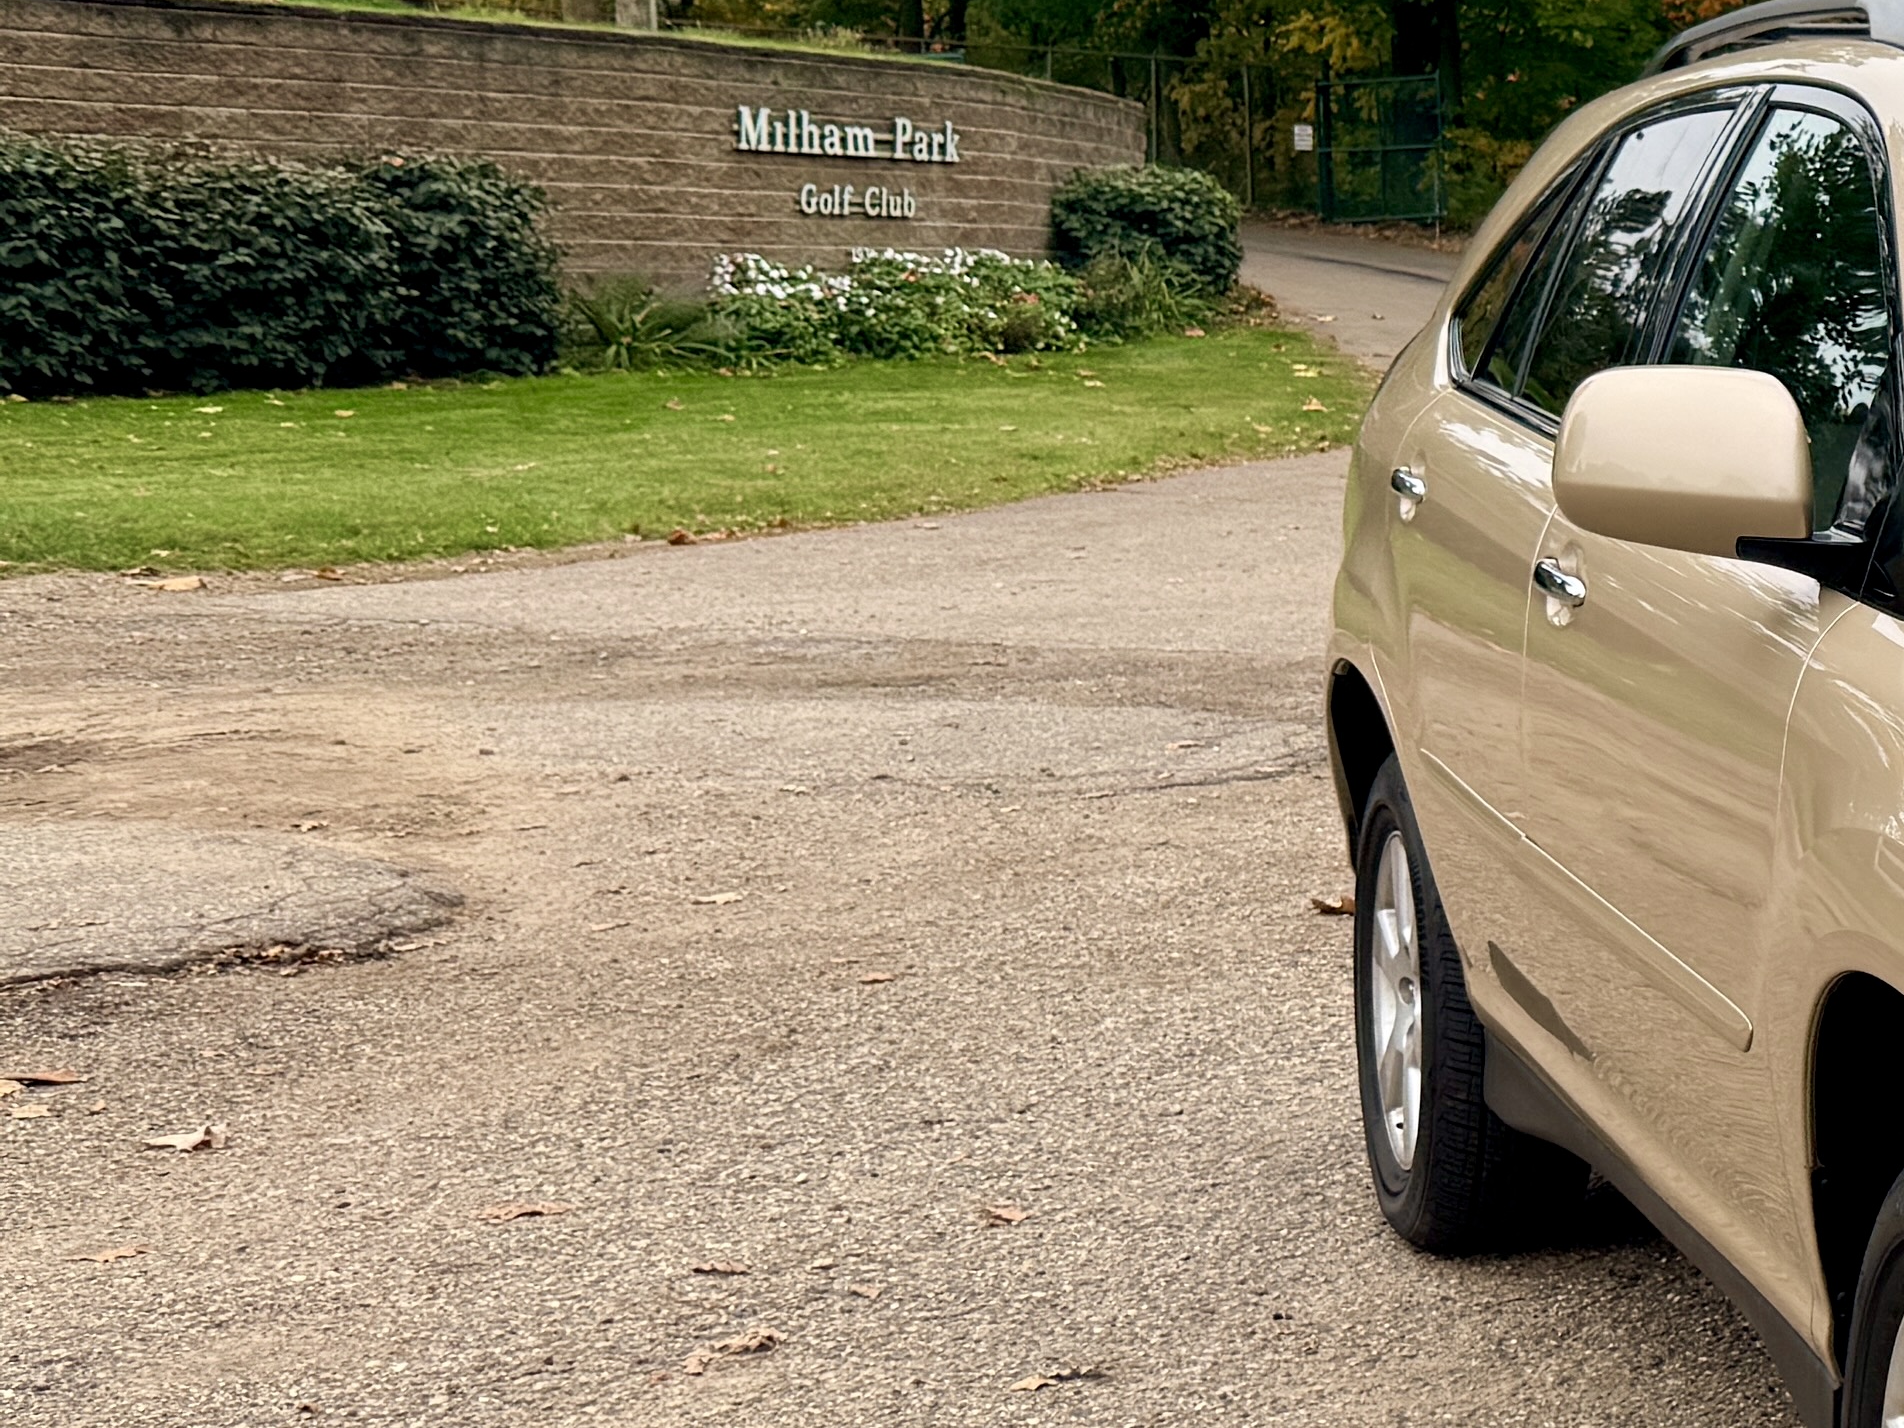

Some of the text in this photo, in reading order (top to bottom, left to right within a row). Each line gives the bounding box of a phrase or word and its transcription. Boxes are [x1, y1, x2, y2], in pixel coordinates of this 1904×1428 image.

[738, 104, 961, 163] Milham Park
[800, 182, 917, 218] Golf Club
